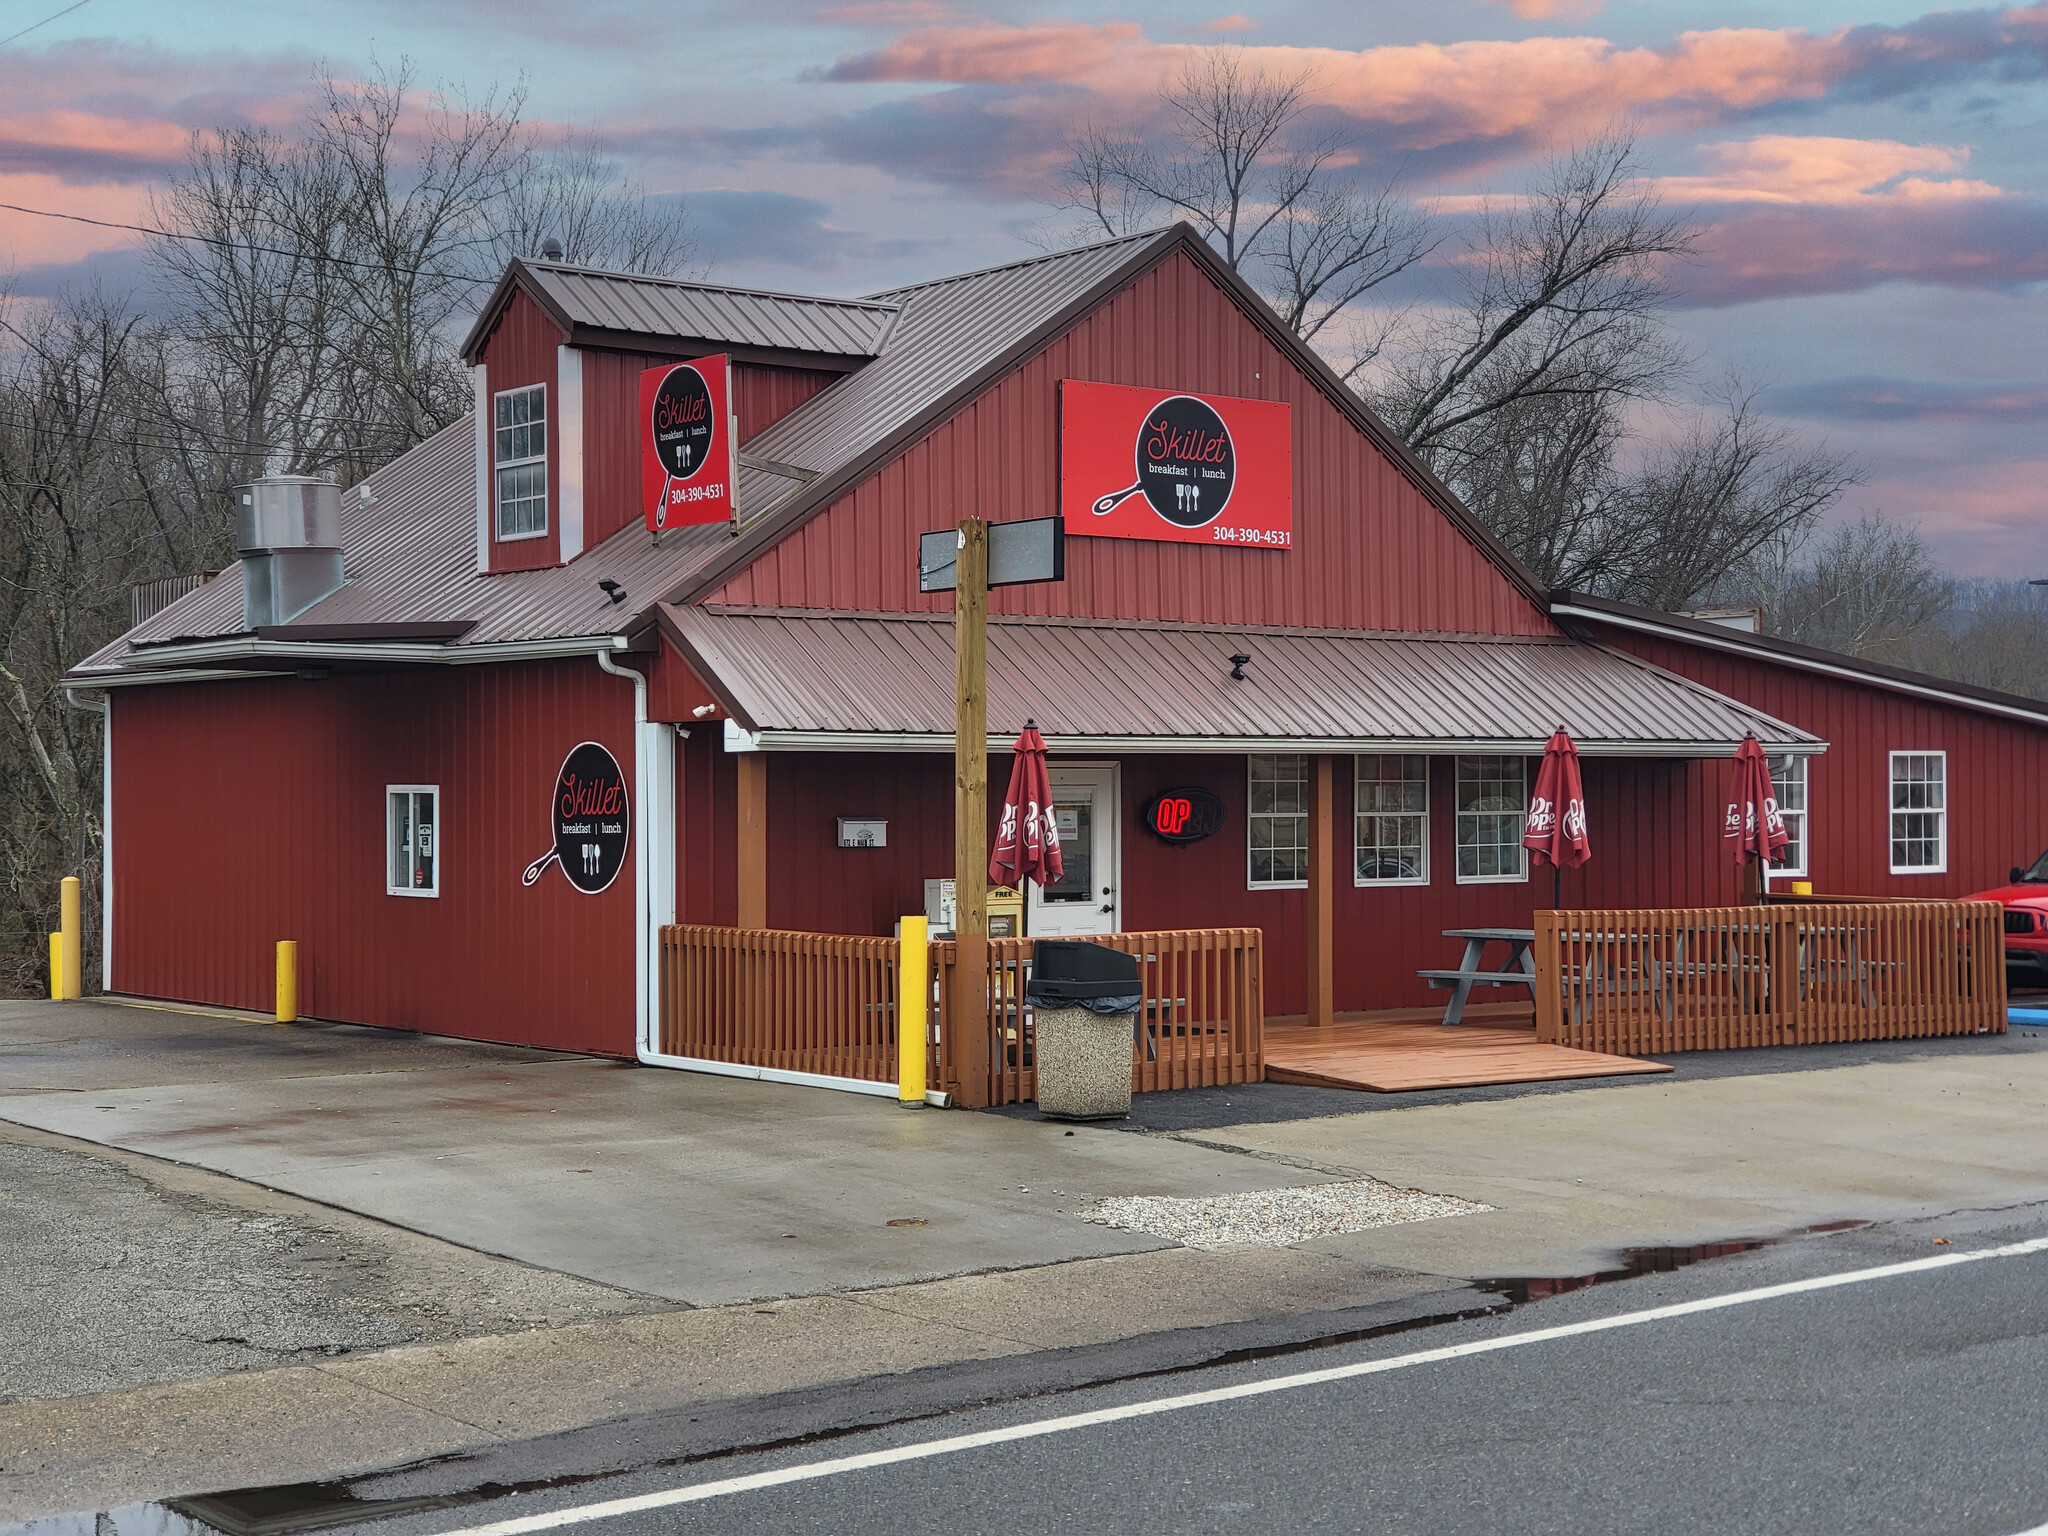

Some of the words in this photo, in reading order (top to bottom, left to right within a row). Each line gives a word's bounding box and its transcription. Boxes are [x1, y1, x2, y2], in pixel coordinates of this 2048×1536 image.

[657, 391, 707, 430] Skillet
[659, 430, 684, 441] breakfast
[691, 426, 707, 436] lunch
[1147, 419, 1227, 463] Skillet
[1148, 463, 1188, 476] breakfast
[1202, 467, 1226, 479] lunch
[671, 483, 725, 505] 304-390-4531
[1213, 526, 1291, 545] 304-390-4531
[560, 773, 622, 819] Skillet
[562, 822, 591, 834] breakfast
[601, 822, 622, 833] lunch
[994, 890, 1013, 898] FREE
